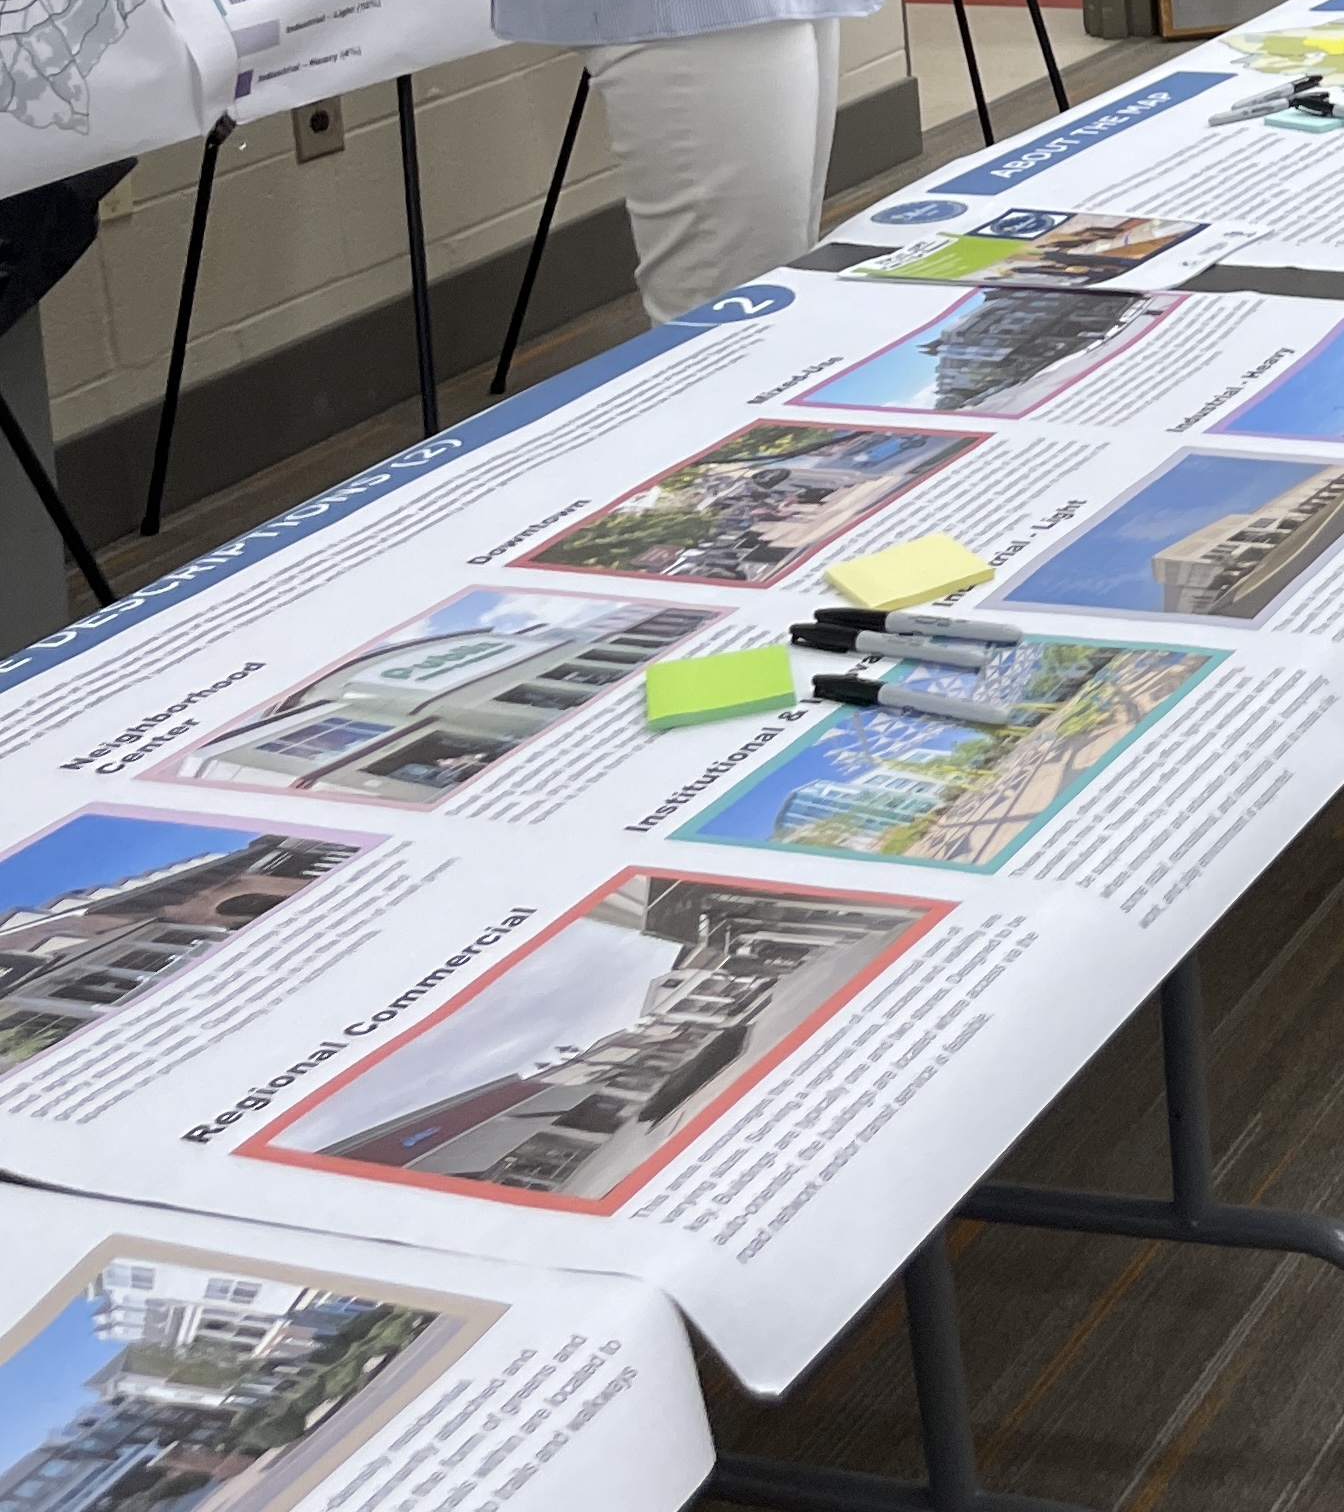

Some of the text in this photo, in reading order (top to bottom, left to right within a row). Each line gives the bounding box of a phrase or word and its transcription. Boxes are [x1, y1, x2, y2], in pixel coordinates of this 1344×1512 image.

[989, 91, 1173, 179] ABOUT THE MAP
[712, 296, 776, 314] 2
[1165, 386, 1244, 432] Industrial
[1241, 347, 1295, 379] Heavy
[35, 472, 391, 648] DESCRIPTIONS
[391, 437, 463, 468] (2)
[466, 499, 592, 565] Downtown
[932, 540, 1031, 607] Intrial
[1031, 499, 1087, 532] Light
[59, 662, 267, 771] Neighborhood
[95, 717, 201, 775] Center
[624, 727, 785, 832] Institutional
[778, 709, 808, 722] &
[179, 1041, 349, 1144] Regional
[343, 907, 538, 1037] Commercial
[500, 1364, 556, 1415] greens
[552, 1334, 587, 1363] and
[502, 1349, 537, 1376] and
[519, 1408, 551, 1434] are
[543, 1353, 606, 1407] located
[598, 1340, 621, 1355] to
[534, 1430, 570, 1463] and
[565, 1366, 637, 1432] walkways
